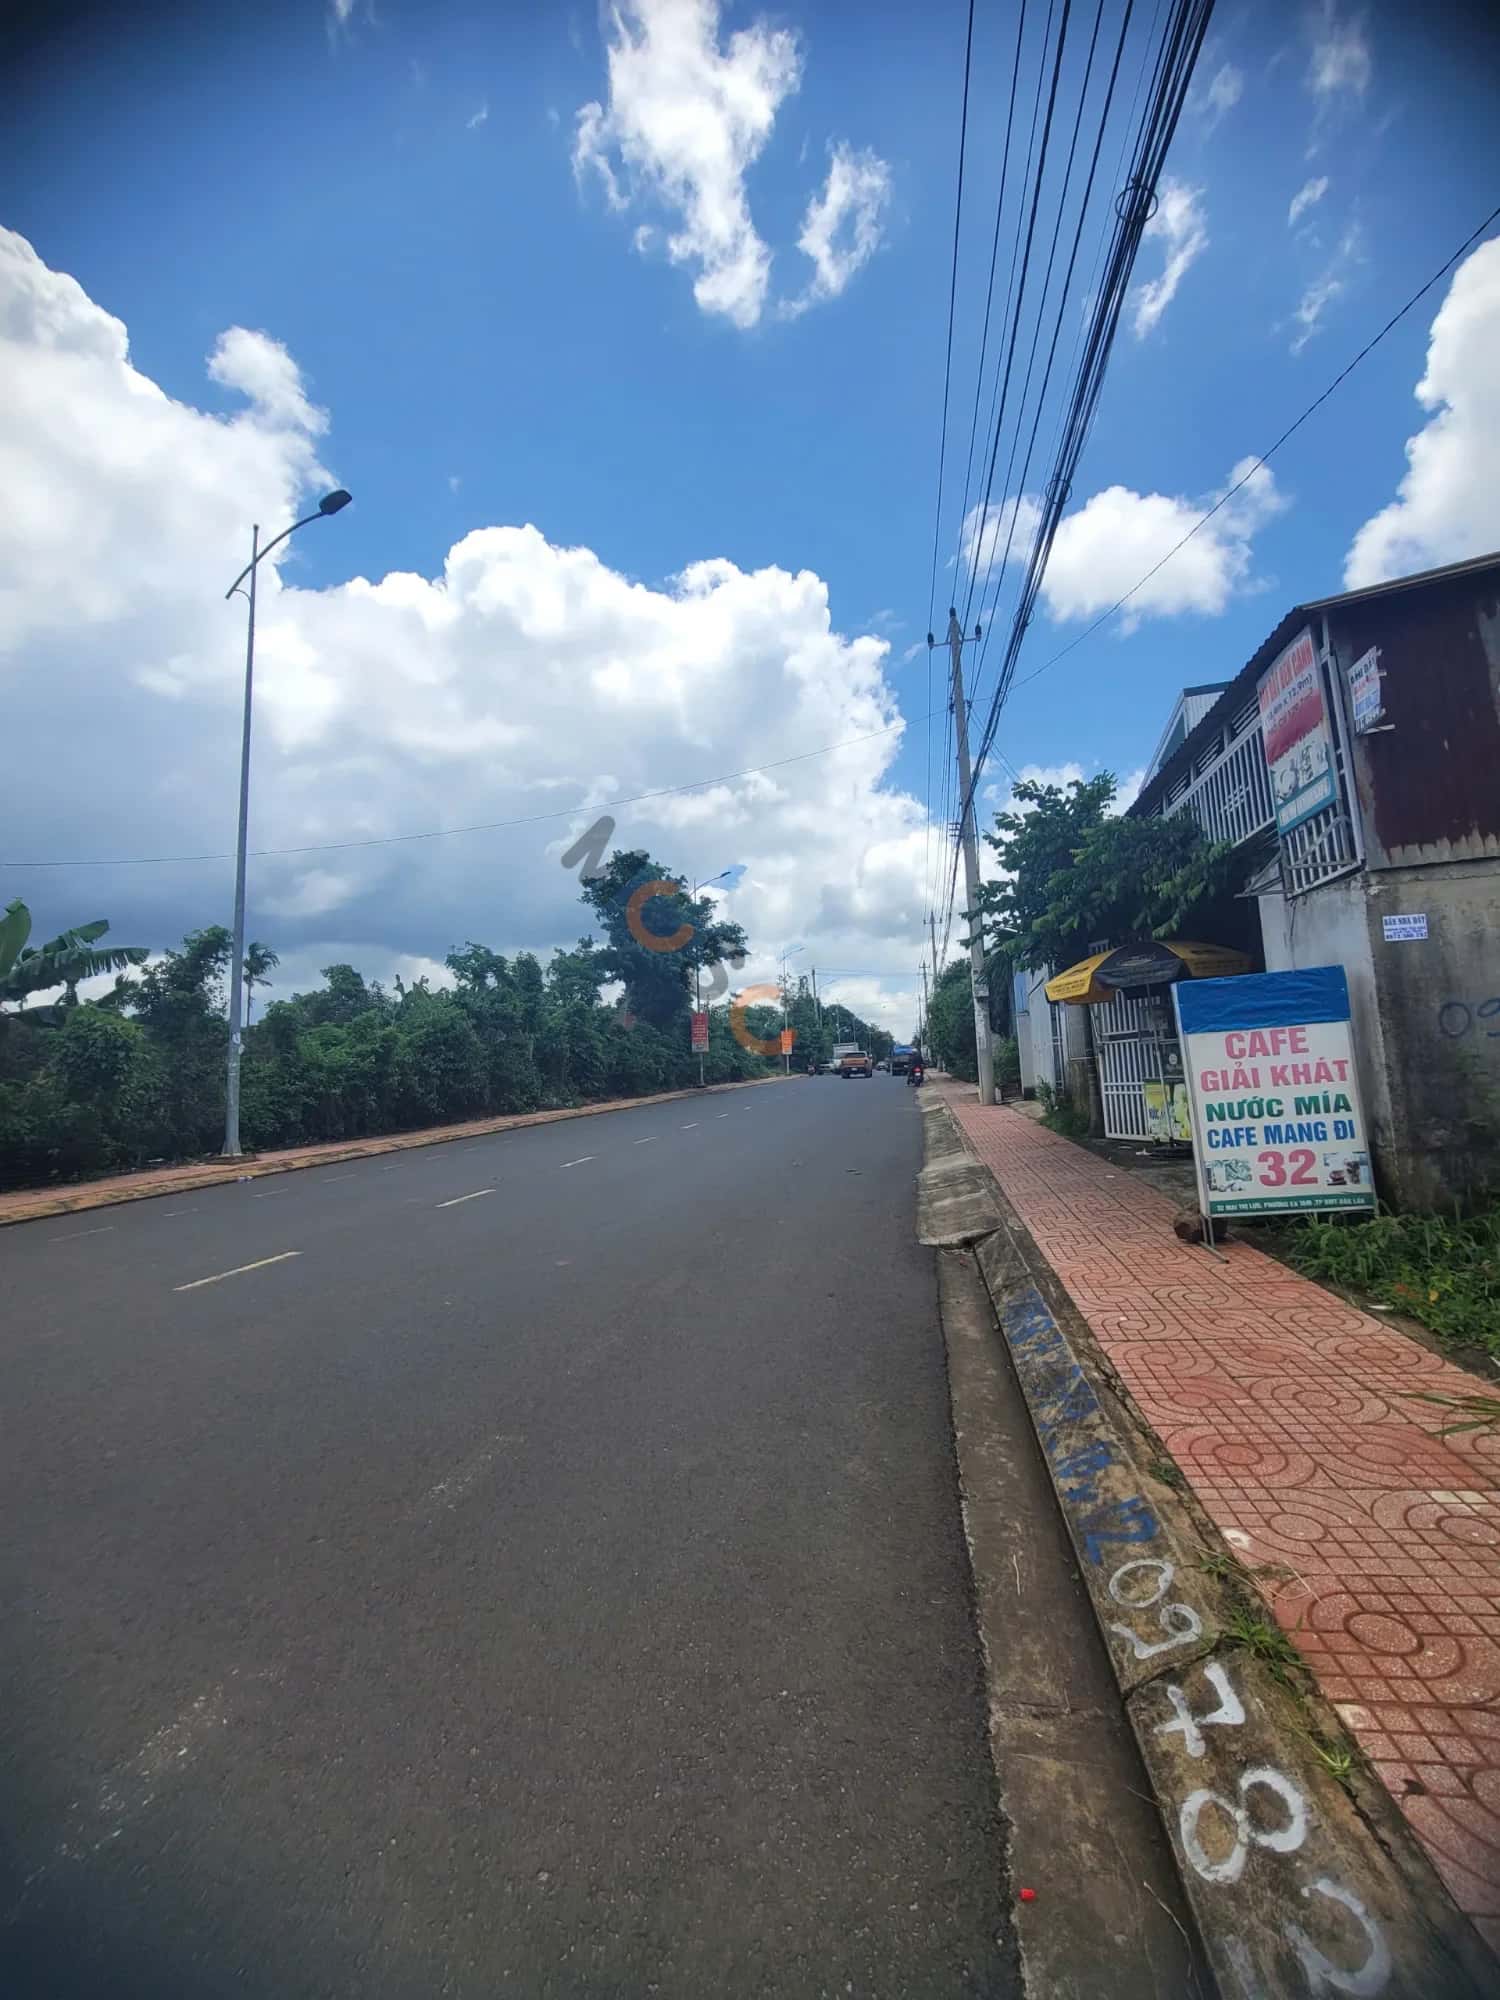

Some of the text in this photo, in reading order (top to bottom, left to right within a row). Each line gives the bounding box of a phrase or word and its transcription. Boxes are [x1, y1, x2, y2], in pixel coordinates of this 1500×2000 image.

[1224, 1027, 1310, 1060] CAFE
[1200, 1057, 1348, 1092] GIẢI KHÁT
[1205, 1091, 1352, 1122] NƯỚC MÍA
[1207, 1119, 1356, 1149] CAFE MANG ĐI
[1257, 1149, 1318, 1187] 32
